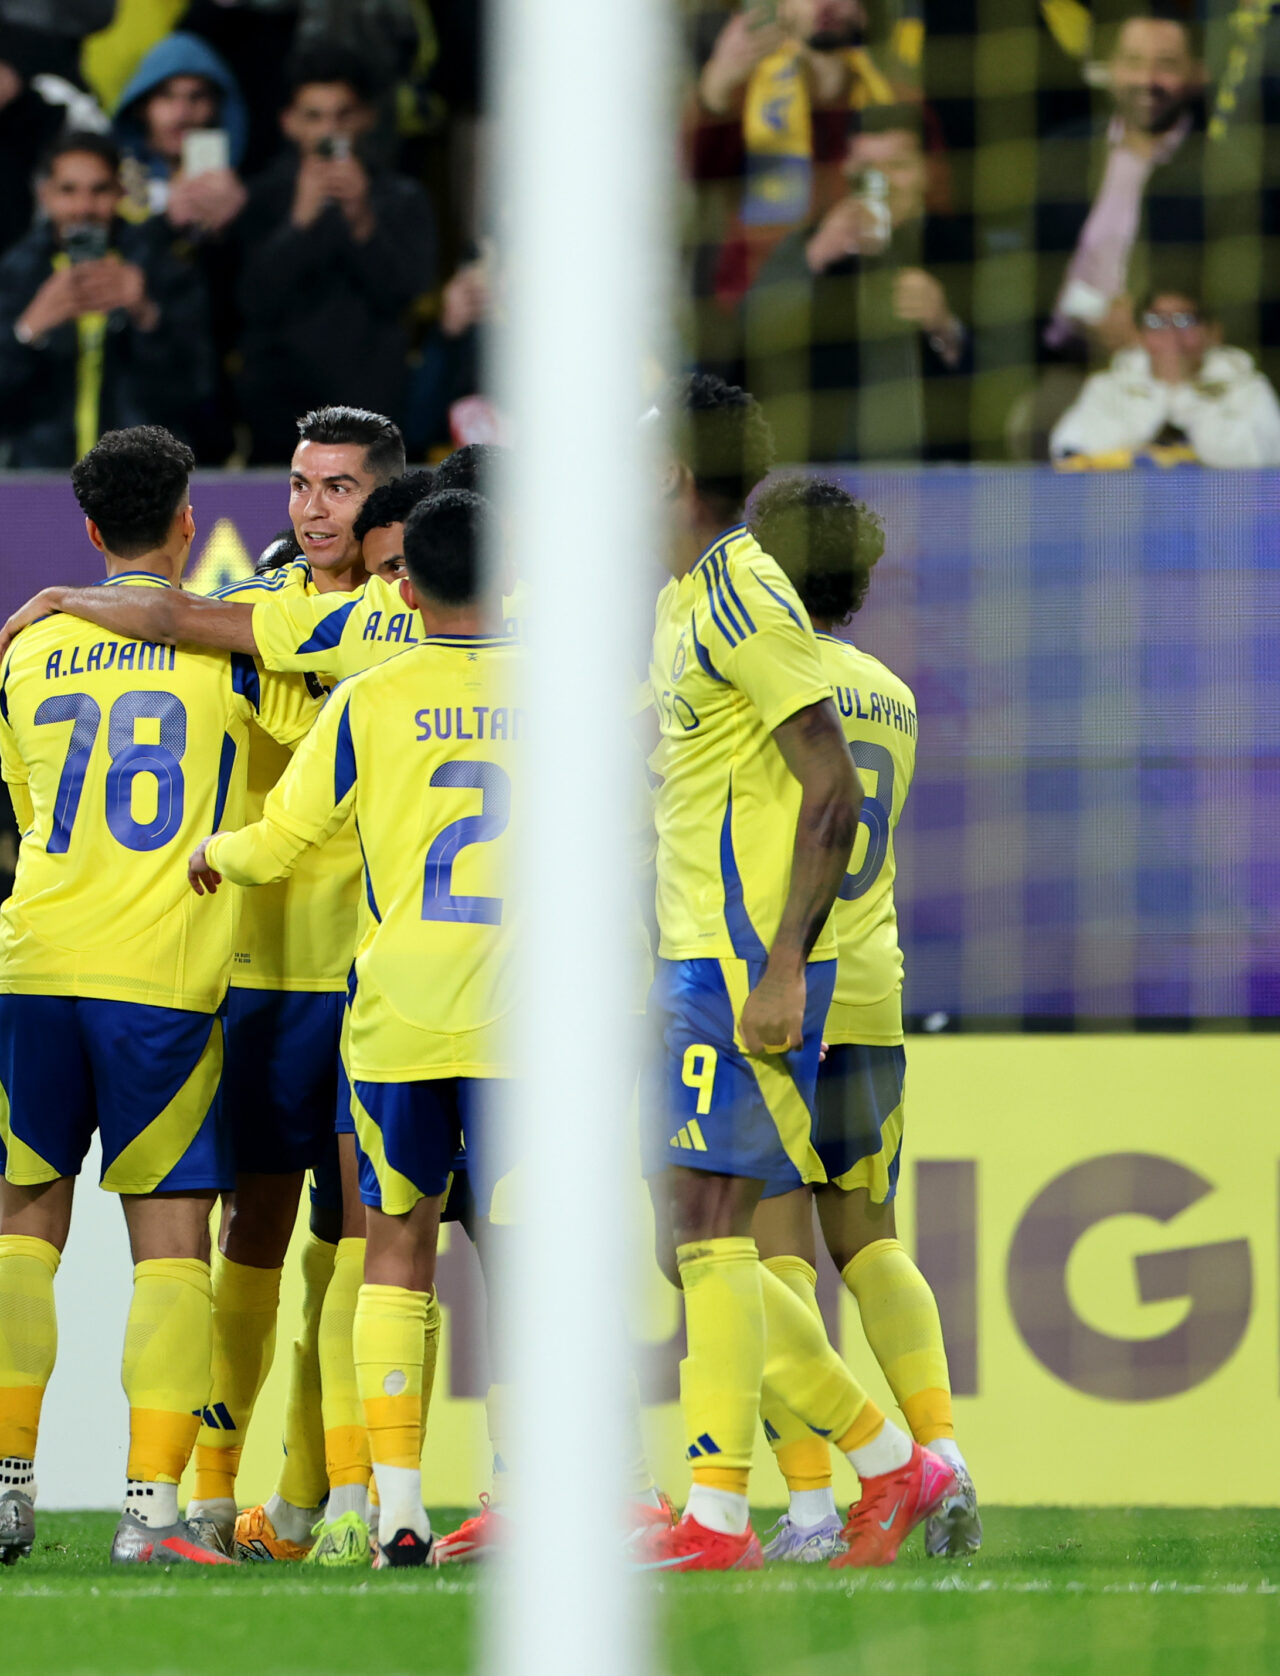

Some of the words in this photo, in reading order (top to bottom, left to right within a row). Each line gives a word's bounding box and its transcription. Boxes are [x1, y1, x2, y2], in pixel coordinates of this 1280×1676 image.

[45, 641, 177, 679] A.LAJAMI
[34, 691, 187, 853] 78
[421, 760, 511, 925] 2
[681, 1043, 718, 1115] 9
